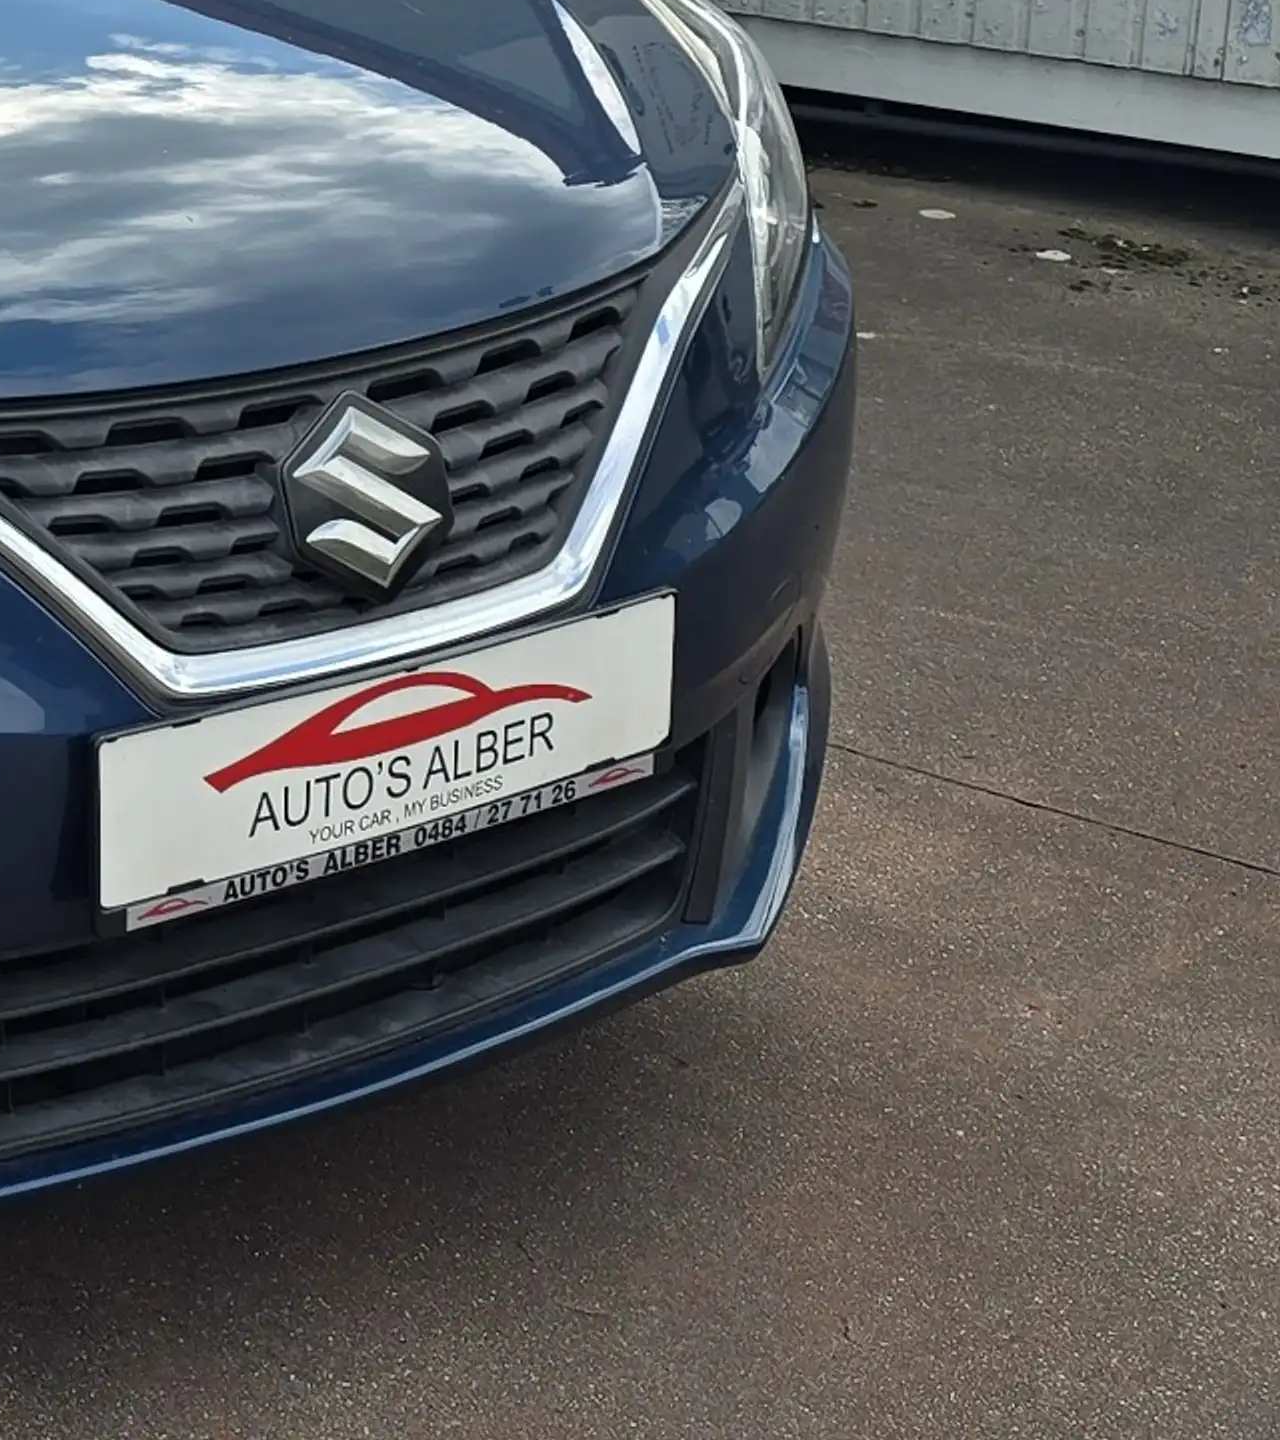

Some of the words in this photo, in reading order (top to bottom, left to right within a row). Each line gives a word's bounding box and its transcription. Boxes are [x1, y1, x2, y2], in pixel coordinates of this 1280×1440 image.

[248, 755, 412, 839] AUTO'S
[421, 711, 556, 792] ALBER
[308, 819, 356, 845] YOUR
[359, 809, 392, 833] CAR
[404, 799, 427, 819] MY
[429, 774, 505, 812] BUSINESS
[223, 859, 311, 903] AUTO'S
[323, 833, 403, 877] ALBER
[414, 814, 468, 847] 0484
[487, 800, 514, 826] 27
[519, 790, 543, 815] 71
[551, 779, 577, 805] 26
